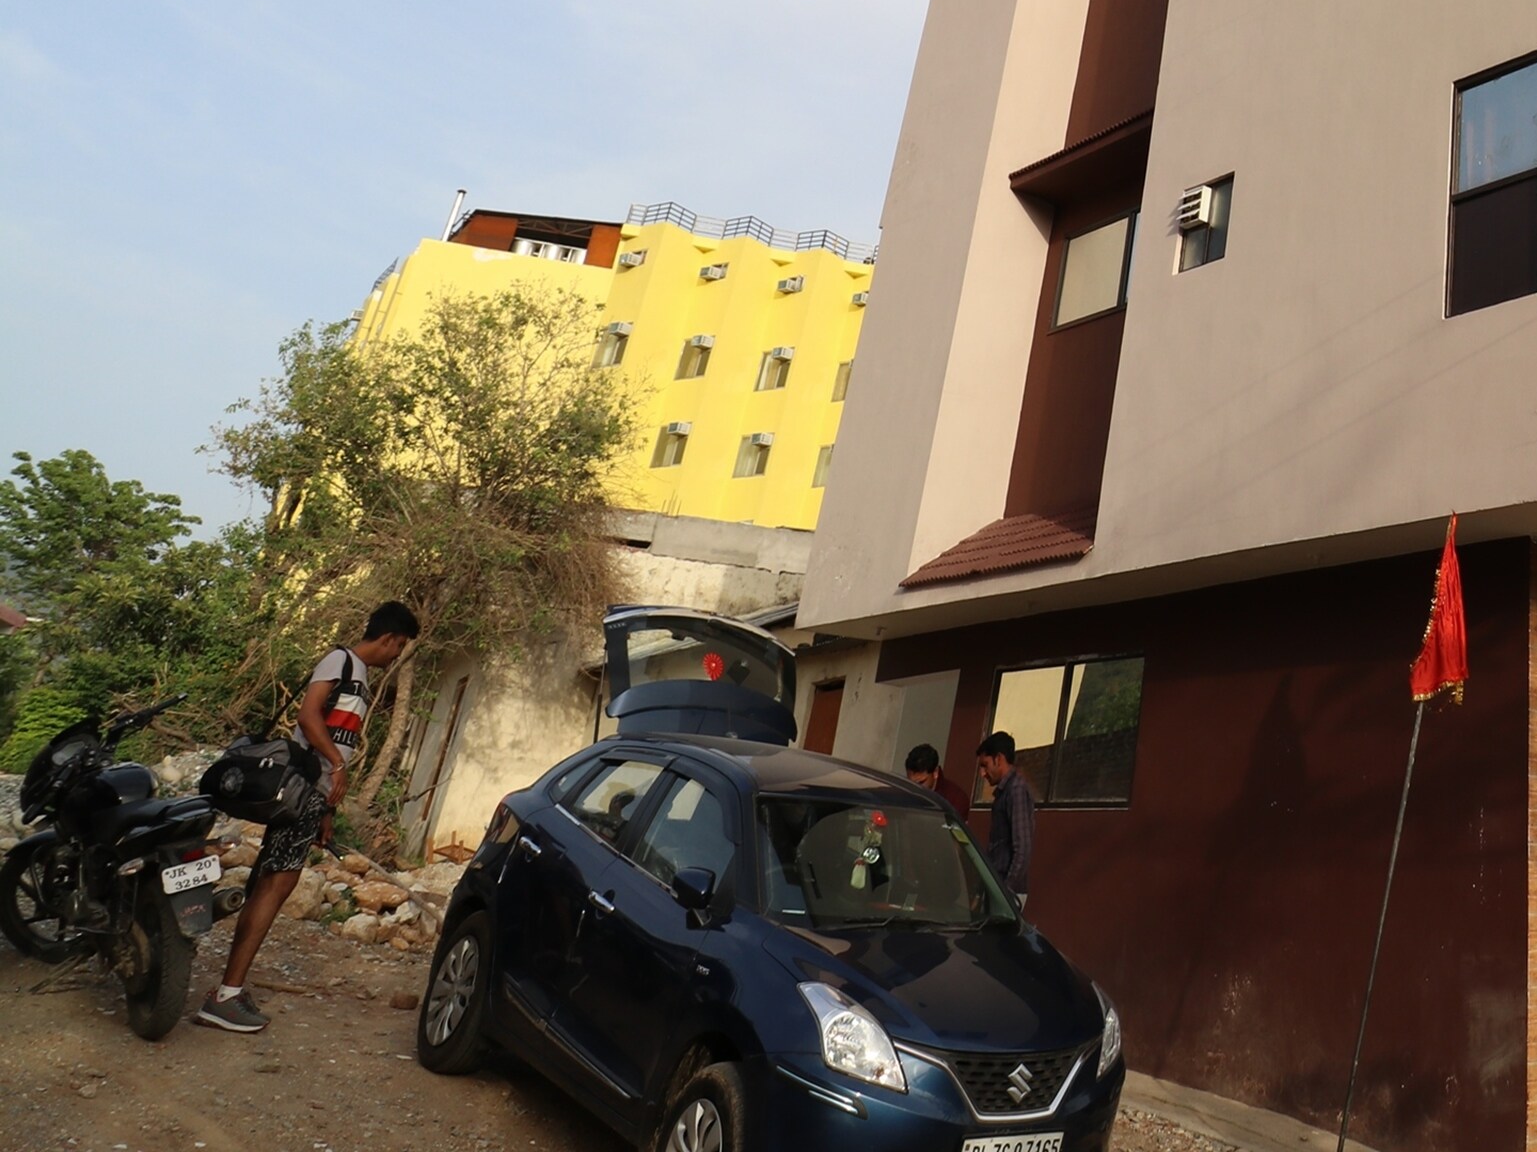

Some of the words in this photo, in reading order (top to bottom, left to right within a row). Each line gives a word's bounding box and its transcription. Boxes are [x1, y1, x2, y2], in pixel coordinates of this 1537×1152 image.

[169, 866, 187, 879] JK
[195, 859, 212, 871] 20
[174, 874, 208, 890] 3284
